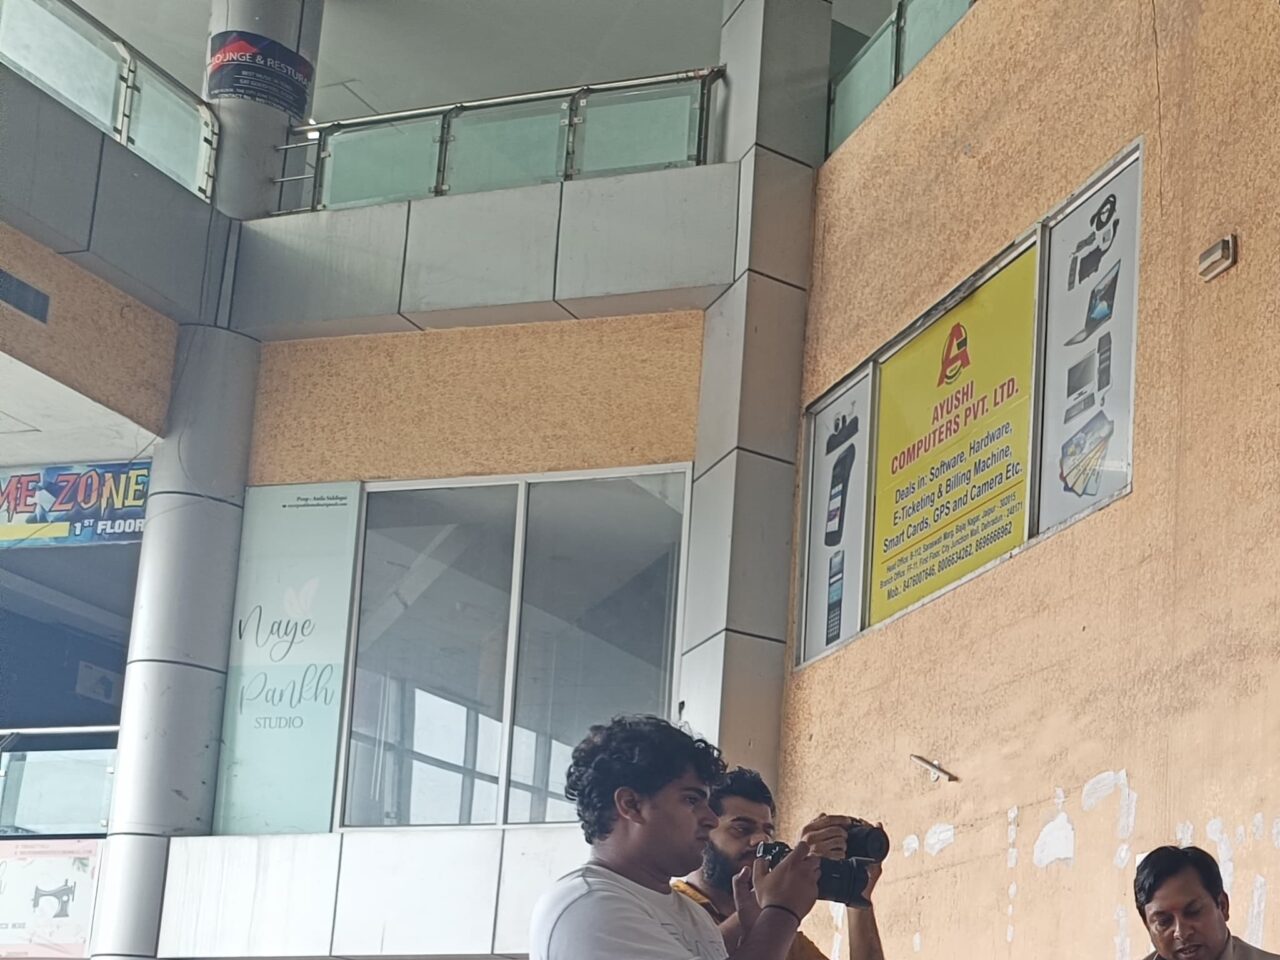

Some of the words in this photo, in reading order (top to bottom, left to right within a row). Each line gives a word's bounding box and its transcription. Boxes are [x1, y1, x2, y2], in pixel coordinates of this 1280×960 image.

[255, 55, 265, 65] &
[266, 57, 309, 85] RESTURA
[891, 414, 960, 475] COMPUTERS
[963, 395, 989, 426] PVT.
[993, 377, 1019, 407] LTD.
[931, 381, 974, 425] AYUSHI
[893, 492, 935, 526] E-Ticketing
[937, 483, 944, 499] &
[945, 469, 971, 496] Billing
[973, 445, 1013, 477] Machine,
[895, 481, 916, 504] Deals
[929, 451, 967, 482] Software,
[968, 422, 1013, 457] Hardware,
[49, 468, 149, 520] ZONE
[883, 530, 905, 553] Smart
[906, 516, 931, 540] Cards,
[933, 500, 951, 523] GPS
[952, 490, 968, 512] and
[970, 472, 1003, 501] Camera
[1005, 462, 1023, 480] Etc.
[96, 519, 145, 535] FLOOR
[239, 604, 316, 663] Naye
[254, 715, 304, 730] STUDIO
